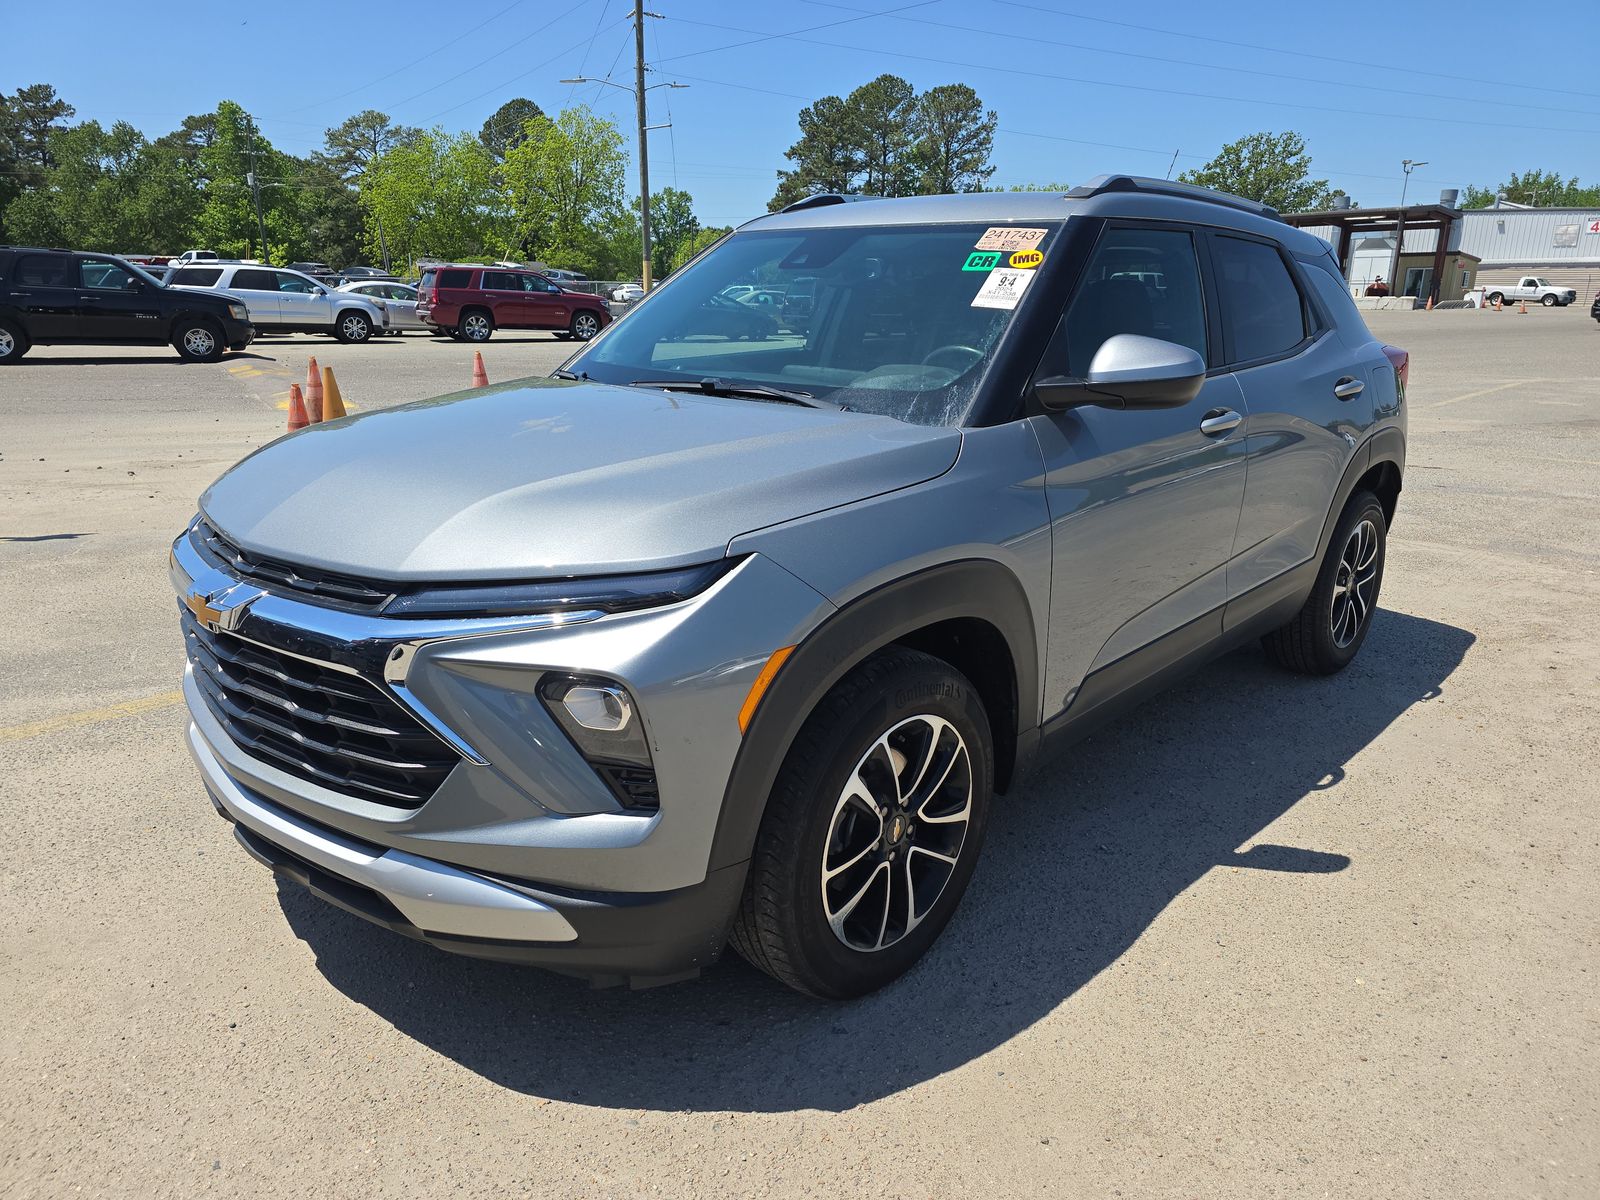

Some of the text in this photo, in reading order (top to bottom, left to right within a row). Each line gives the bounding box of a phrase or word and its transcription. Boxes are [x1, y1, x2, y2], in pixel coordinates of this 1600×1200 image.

[1590, 221, 1600, 232] 4
[985, 230, 1045, 240] 2417437
[968, 255, 996, 267] CR
[1012, 253, 1039, 264] IMG
[895, 681, 954, 708] Continental
